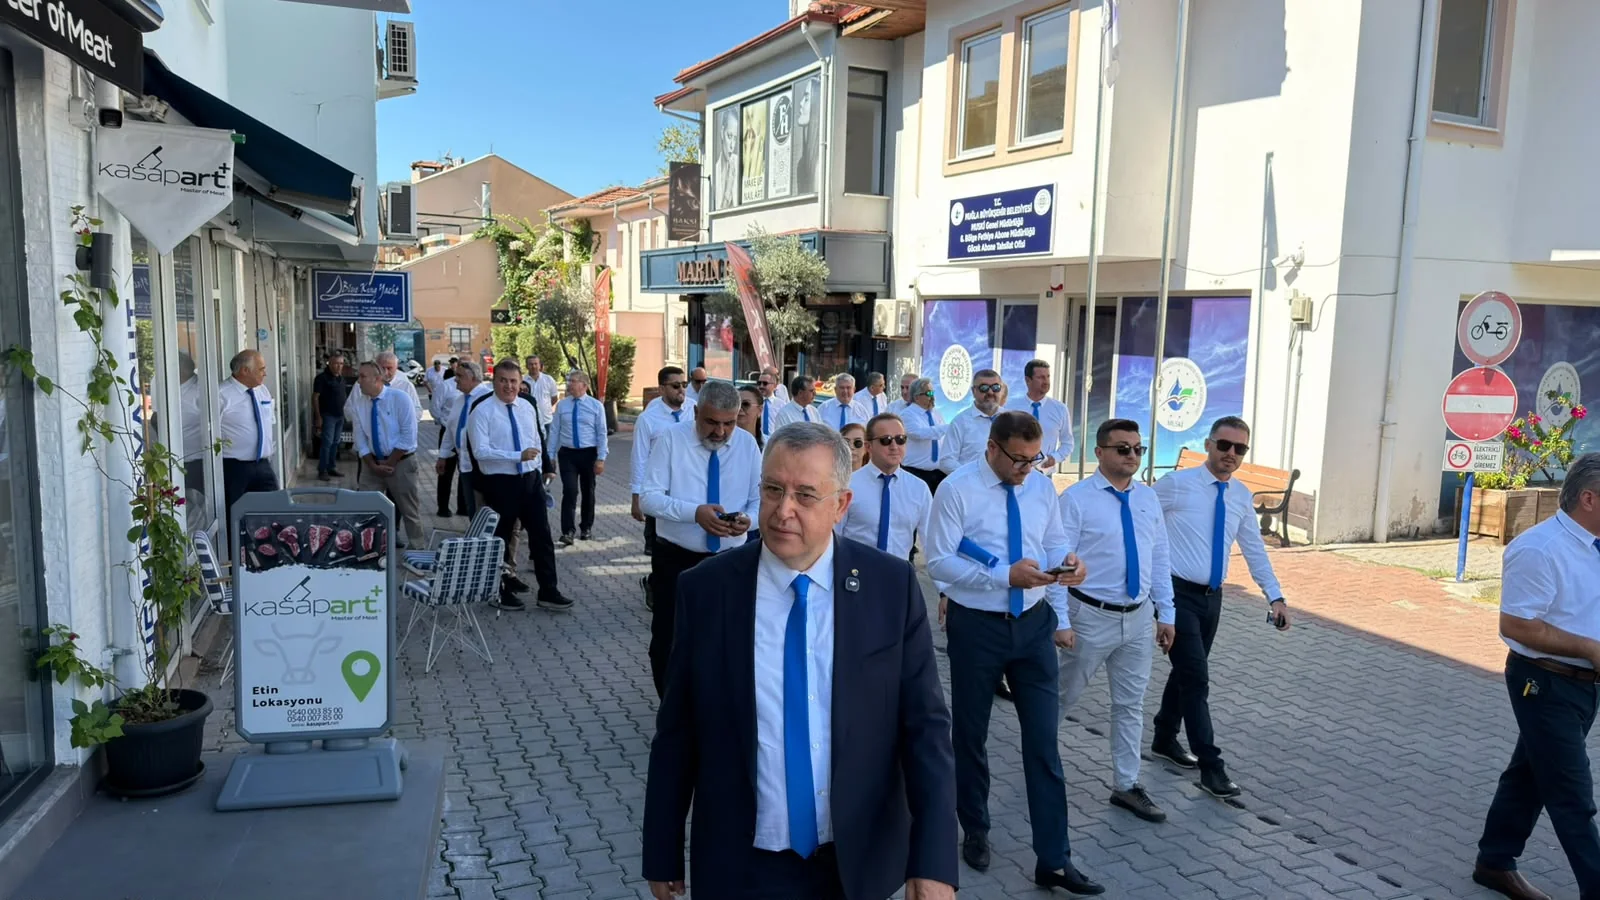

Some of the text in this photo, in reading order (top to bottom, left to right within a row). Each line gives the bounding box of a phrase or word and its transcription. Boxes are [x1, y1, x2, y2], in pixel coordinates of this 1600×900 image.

[47, 0, 65, 37] of
[67, 10, 116, 68] Meat
[379, 283, 400, 299] Yacht
[252, 685, 279, 695] Etin
[252, 697, 323, 708] Lokasyonu
[287, 715, 306, 723] 0540
[307, 714, 321, 722] 007
